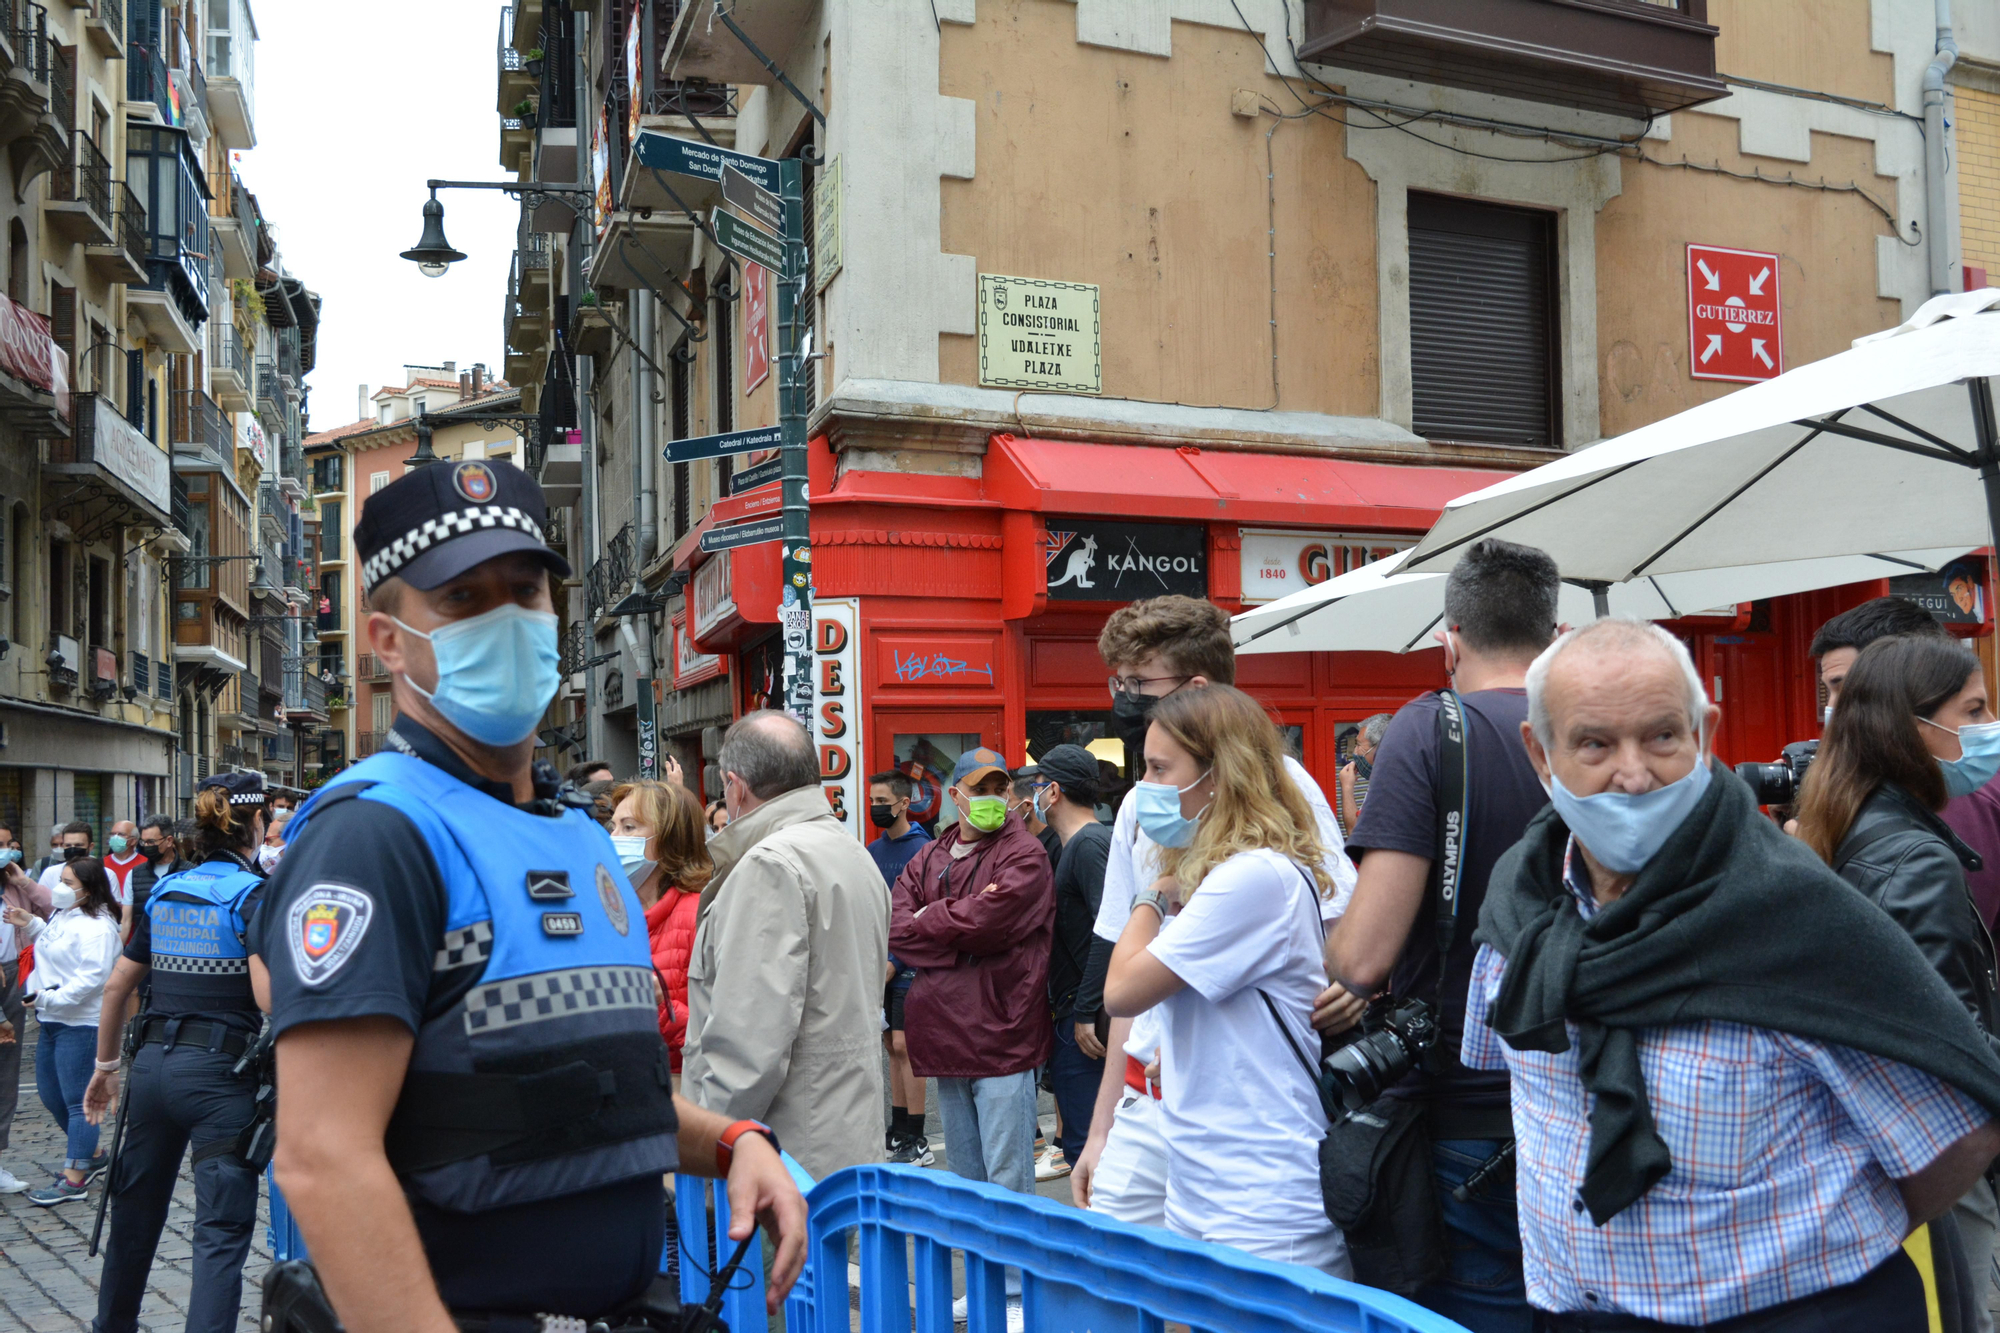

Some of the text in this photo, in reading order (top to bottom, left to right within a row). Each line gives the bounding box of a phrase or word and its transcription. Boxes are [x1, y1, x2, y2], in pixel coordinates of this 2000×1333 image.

[682, 146, 767, 174] Mercado de Santo Domingo
[689, 161, 702, 172] San
[750, 231, 767, 247] Educación
[1024, 294, 1058, 310] PLAZA
[1002, 312, 1080, 332] CONSISTORIAL
[1696, 304, 1774, 325] GUTIERREZ
[1024, 360, 1062, 376] PLAZA
[719, 437, 742, 449] Catedral
[746, 433, 772, 445] Katedrala
[111, 425, 156, 483] AGREEMENT
[745, 499, 760, 509] Encierro
[708, 535, 721, 544] Museo
[721, 530, 739, 541] diocesano
[764, 525, 780, 534] museoa
[1108, 554, 1199, 573] KANGOL
[1263, 557, 1282, 566] desde
[1260, 569, 1286, 579] 1840
[1442, 810, 1460, 901] OLYMPUS
[152, 905, 219, 926] POLICIA
[152, 924, 220, 940] MUNICIPAL
[548, 918, 576, 930] 0459
[152, 938, 220, 955] UDALTZAINGOA
